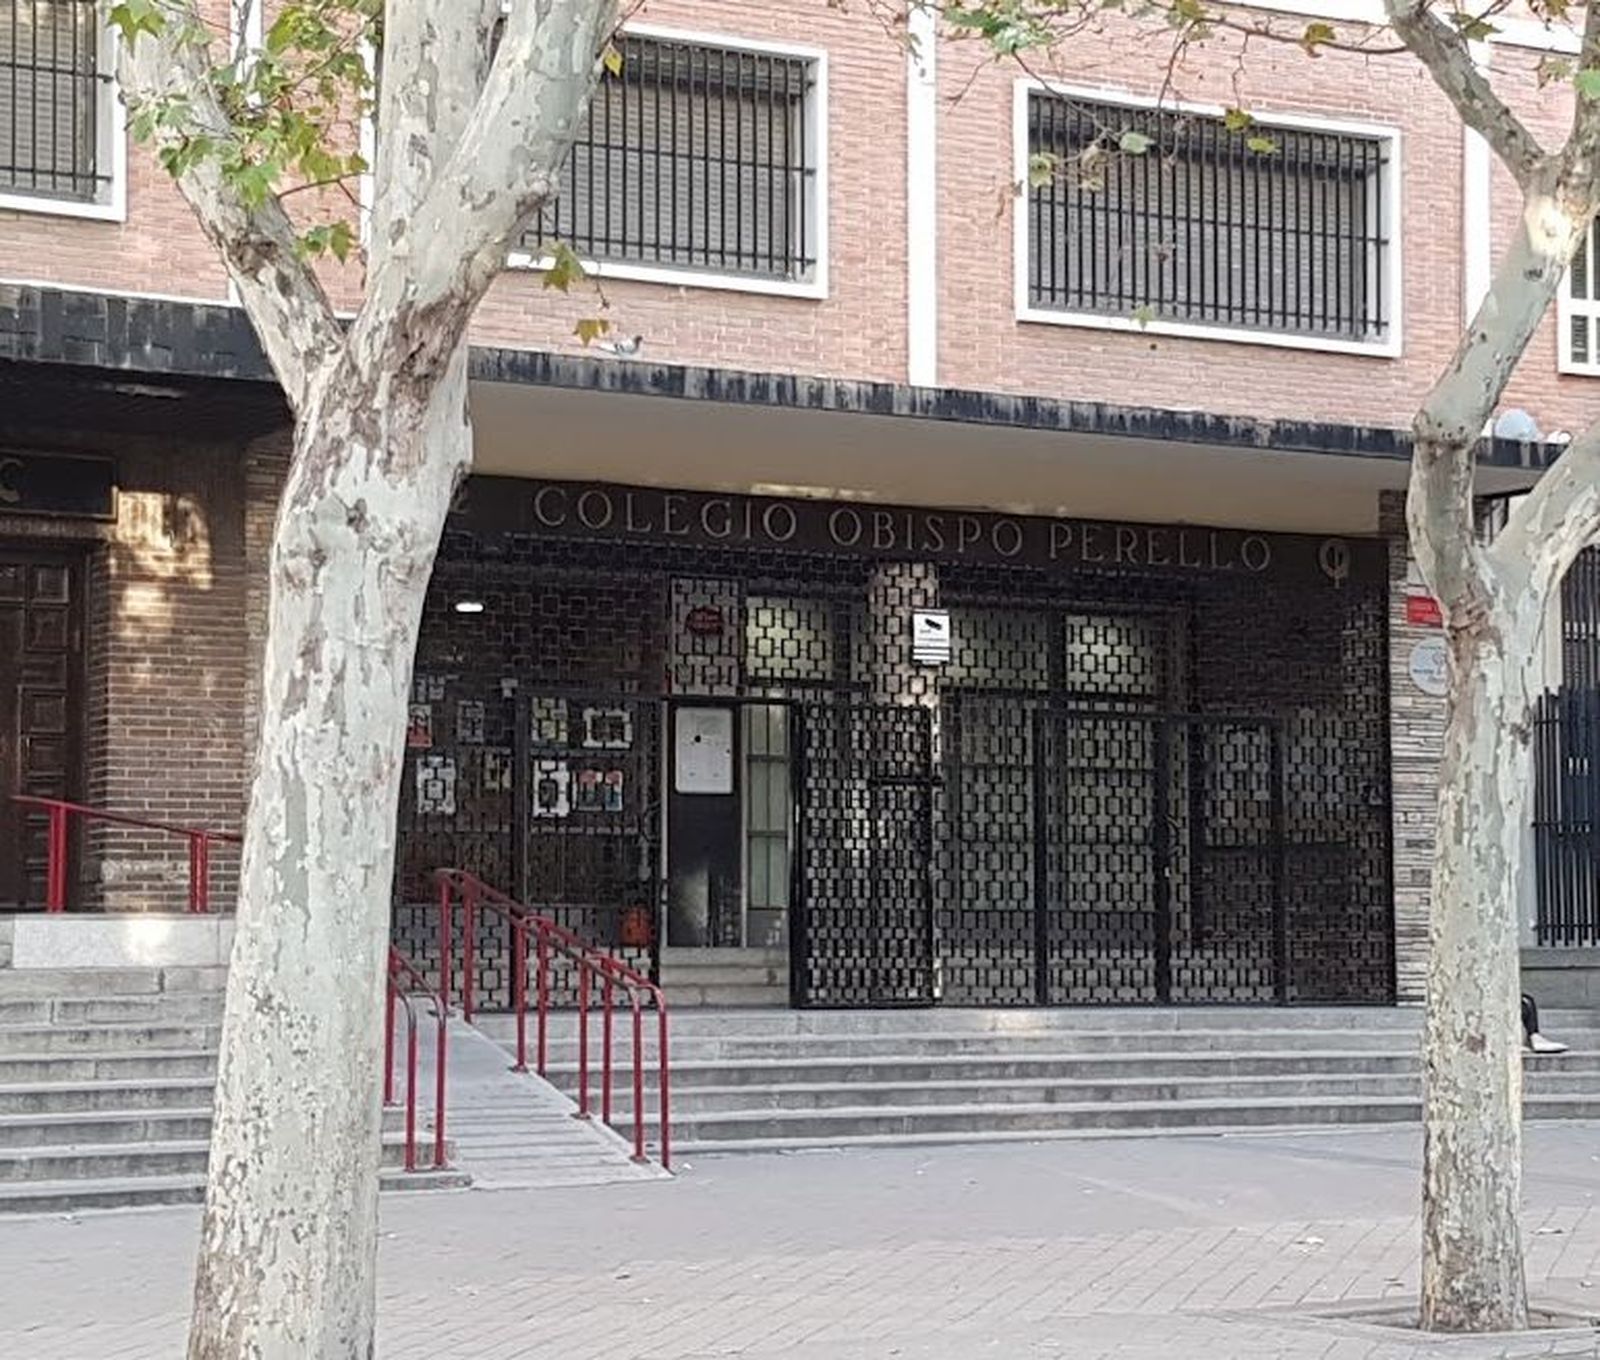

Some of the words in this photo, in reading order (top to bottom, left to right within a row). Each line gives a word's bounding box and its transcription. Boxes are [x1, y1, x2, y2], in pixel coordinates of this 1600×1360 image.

[534, 486, 797, 542] COLEGIO
[828, 507, 1023, 557] OBISPO
[1049, 521, 1272, 571] PERELLO
